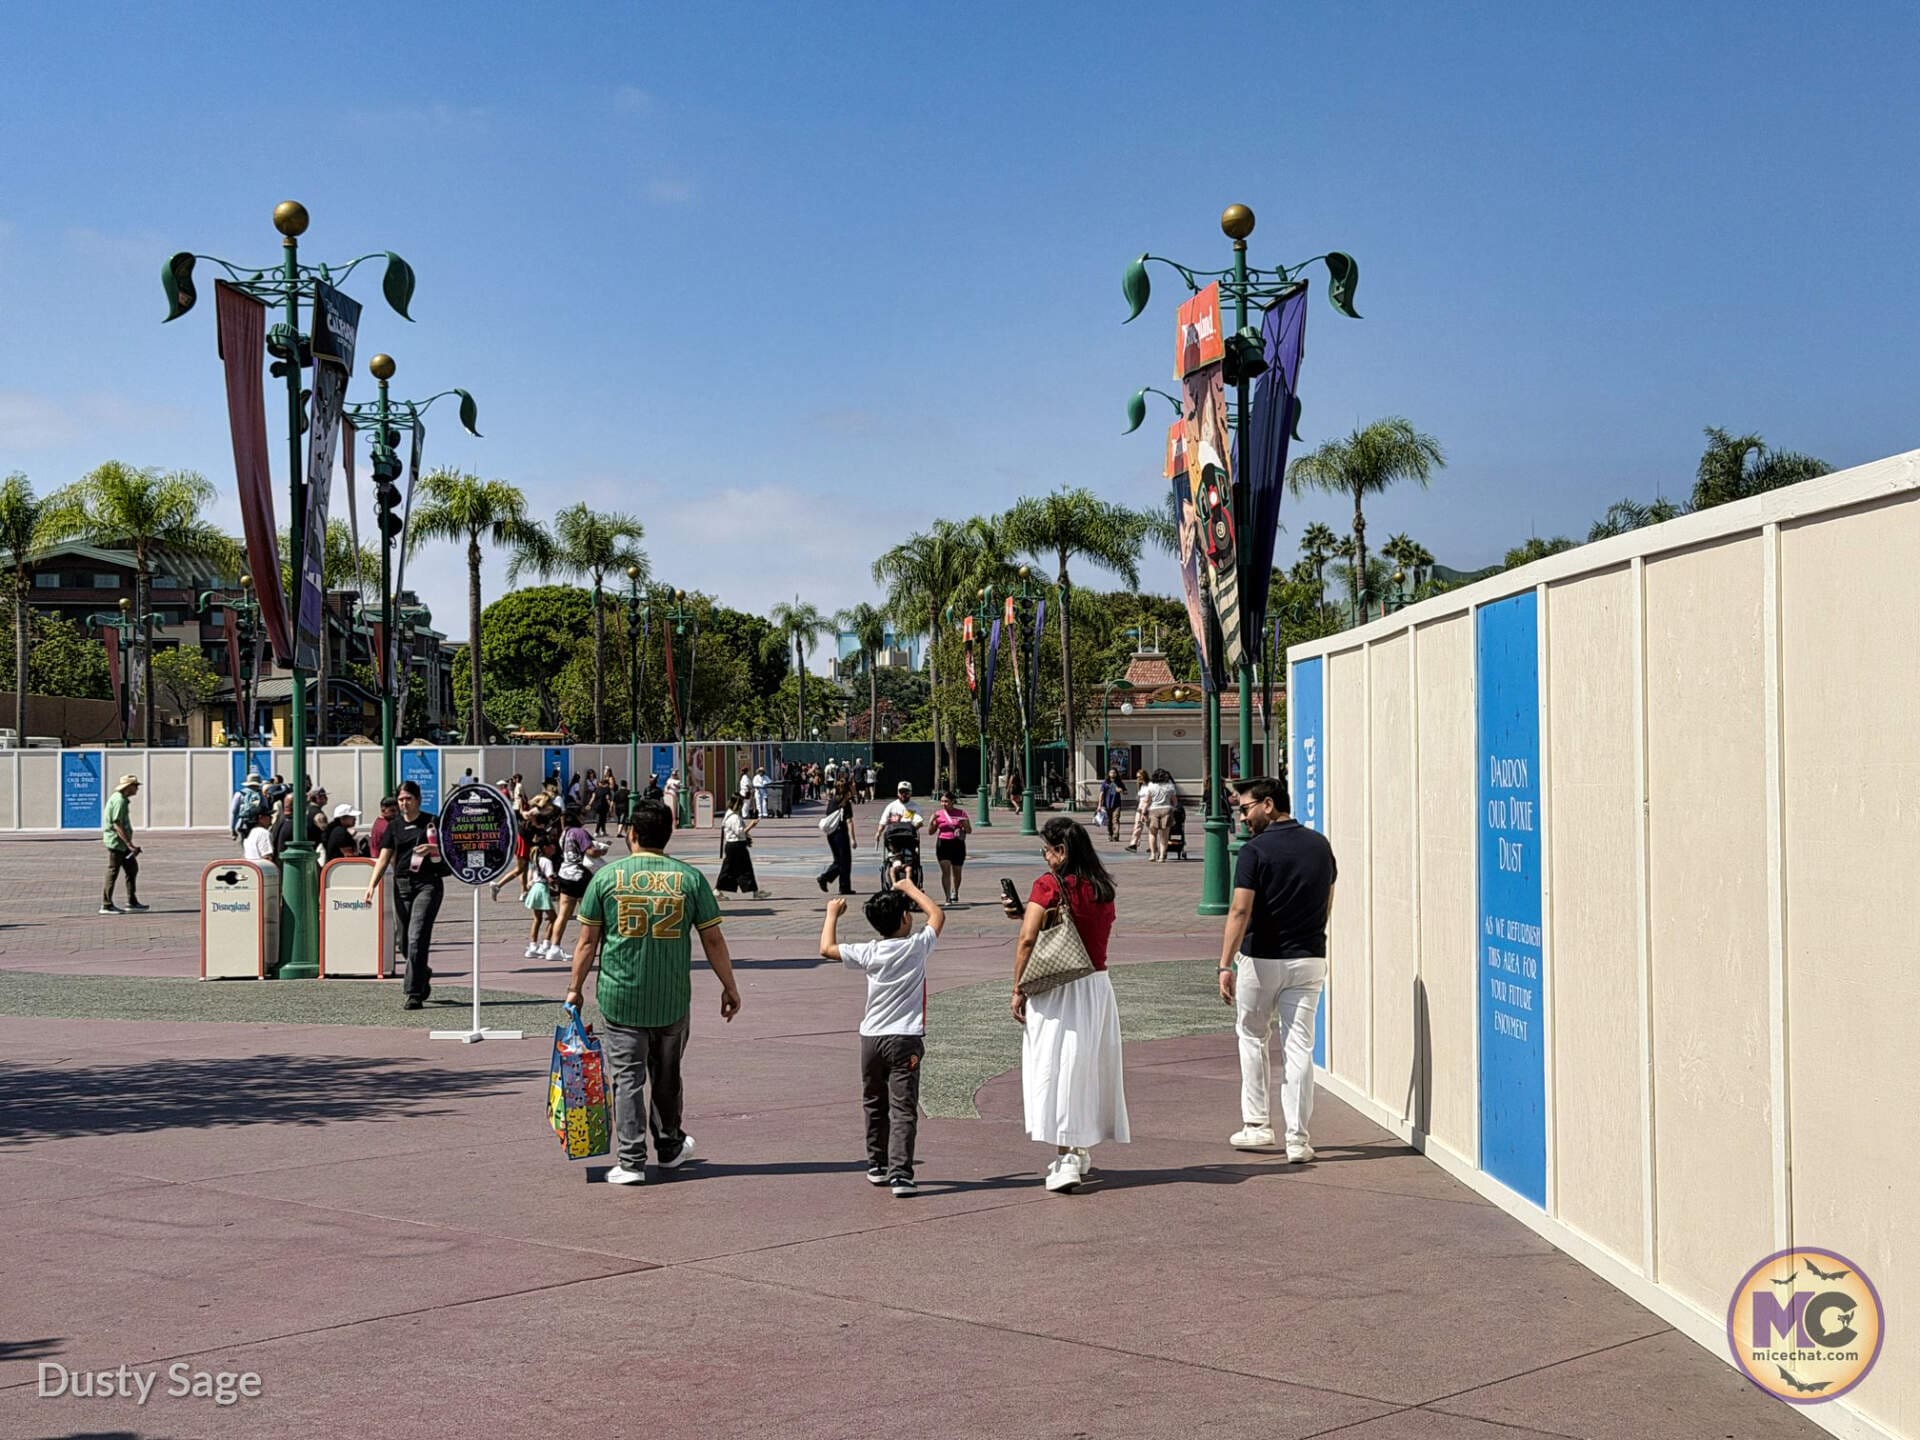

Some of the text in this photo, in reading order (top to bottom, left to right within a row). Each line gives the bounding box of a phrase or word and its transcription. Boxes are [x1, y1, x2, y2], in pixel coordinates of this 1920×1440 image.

[1490, 755, 1529, 788] PARDON
[1488, 796, 1534, 831] OUR PIXIE
[1498, 837, 1523, 873] DUST
[615, 869, 686, 897] LOKI
[212, 901, 251, 912] Disneyland
[613, 895, 686, 939] 62
[1522, 956, 1537, 980] FOR
[1508, 984, 1532, 1011] FUTURE
[1494, 1011, 1528, 1041] ENJOYMENT
